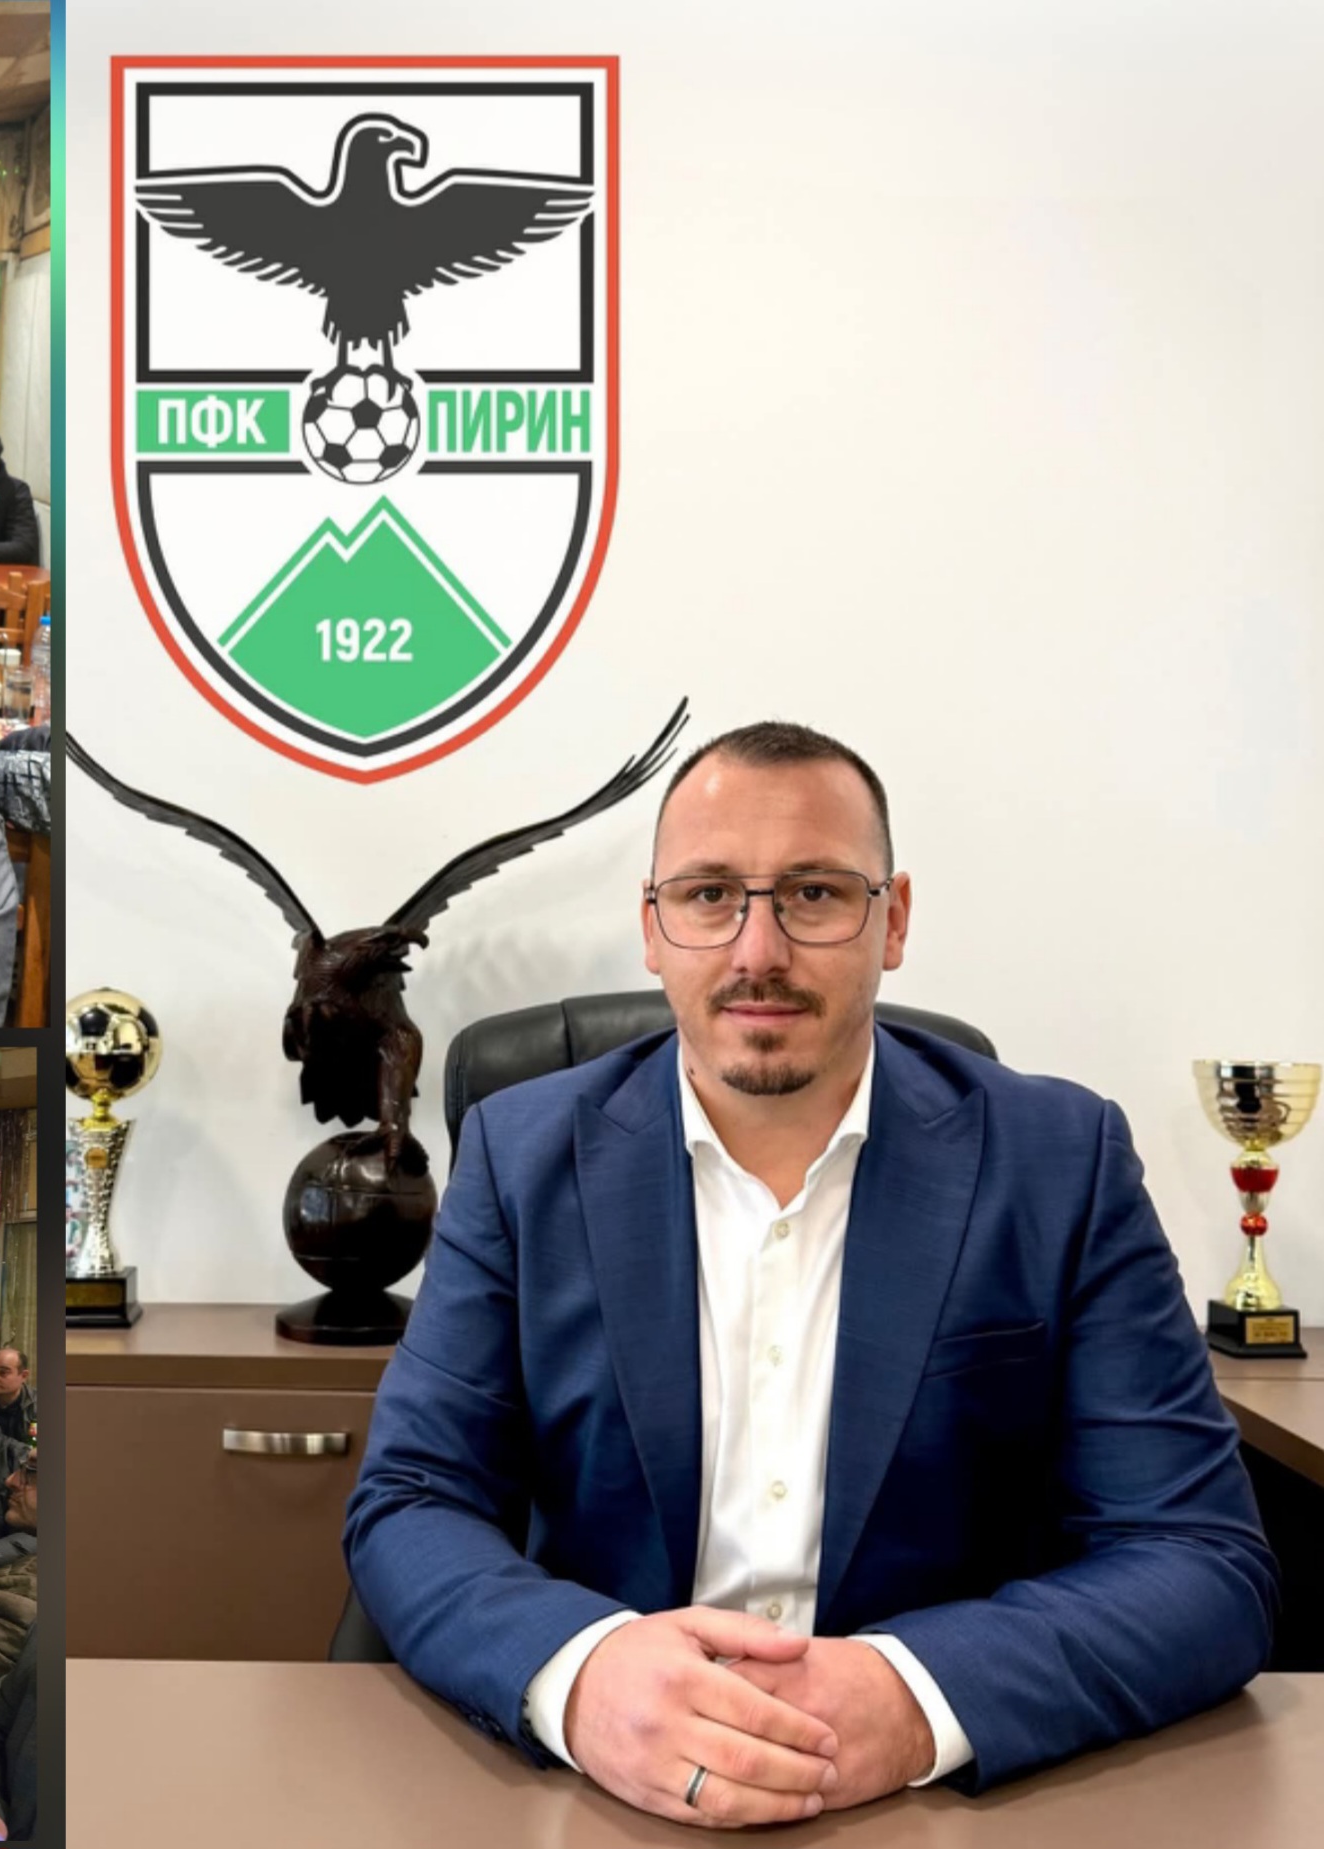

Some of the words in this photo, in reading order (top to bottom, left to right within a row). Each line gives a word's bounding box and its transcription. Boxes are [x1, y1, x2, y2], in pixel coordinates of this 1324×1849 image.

[157, 394, 268, 449] ПФК
[428, 389, 591, 453] ПИРИН
[316, 618, 413, 662] 1922
